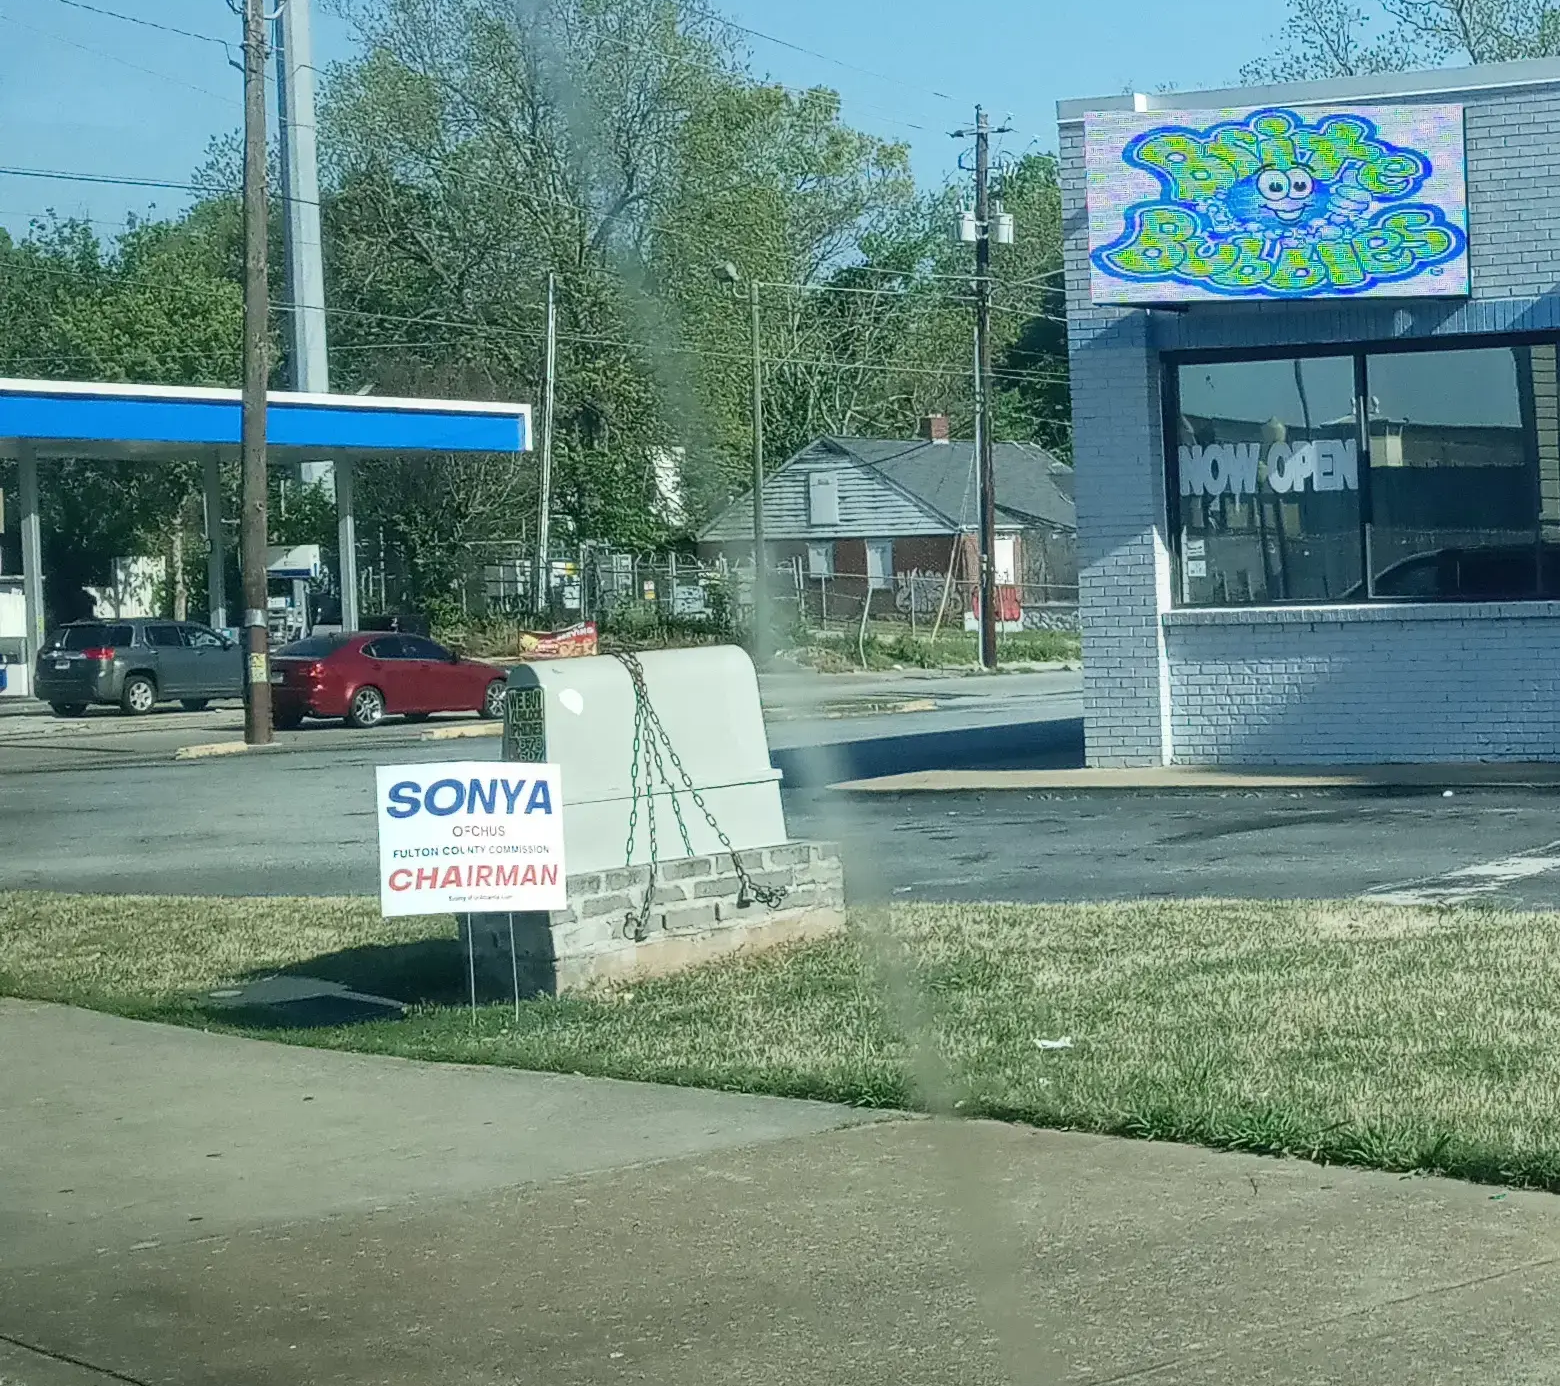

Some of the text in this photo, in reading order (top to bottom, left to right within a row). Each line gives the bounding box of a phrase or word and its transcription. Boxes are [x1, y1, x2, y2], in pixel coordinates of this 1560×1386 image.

[1178, 438, 1359, 496] NOW OPEN
[509, 690, 541, 710] WE BUY
[519, 750, 544, 762] 607
[386, 778, 553, 819] SONYA
[393, 844, 550, 859] FULTON COUNTY COMMISSION
[388, 863, 558, 892] CHAIRMAN
